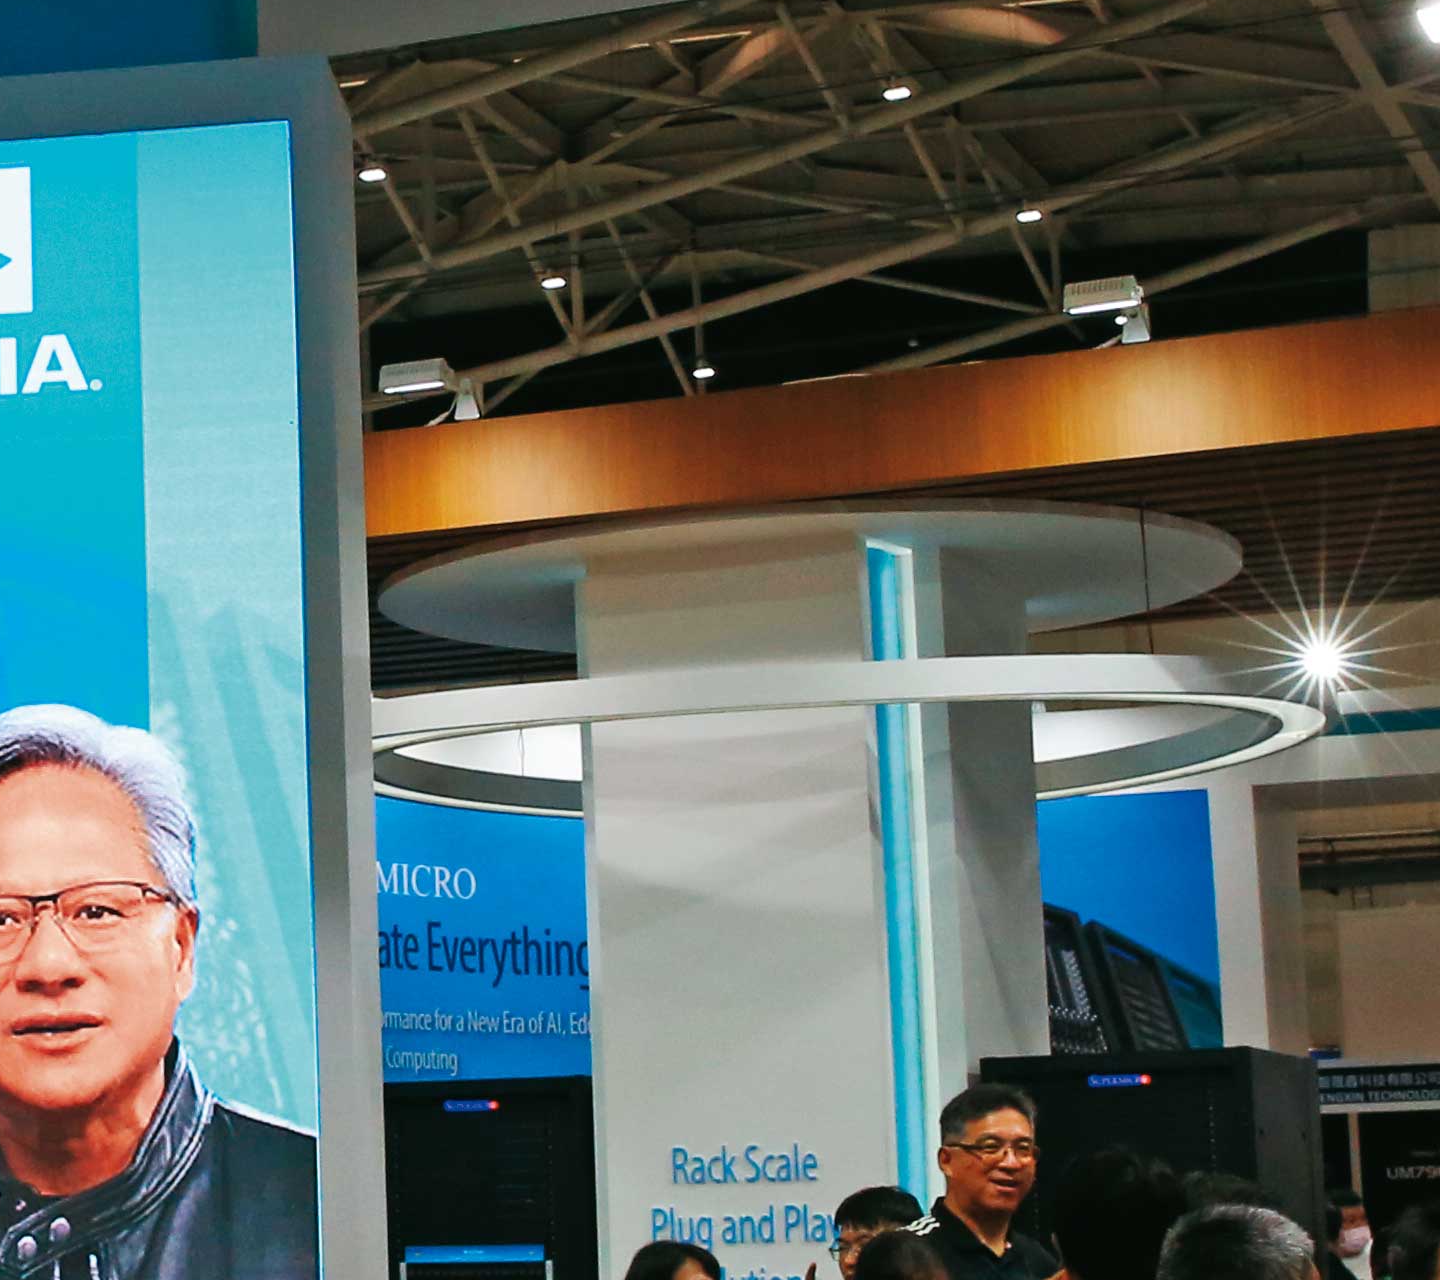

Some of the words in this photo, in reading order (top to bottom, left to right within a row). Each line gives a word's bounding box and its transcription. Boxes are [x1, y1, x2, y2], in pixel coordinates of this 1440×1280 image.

[376, 862, 477, 900] MICRO
[379, 924, 419, 970] ate
[382, 1011, 432, 1031] rmance
[434, 1008, 452, 1031] for
[457, 1015, 465, 1031] a
[467, 1011, 500, 1032] New
[503, 1011, 525, 1034] Era
[528, 1011, 544, 1034] of
[570, 1012, 591, 1035] Ed
[385, 1045, 458, 1076] Computing
[672, 1147, 735, 1184] Rack
[744, 1144, 818, 1184] Scale
[651, 1209, 713, 1250] Plug
[721, 1206, 778, 1245] and
